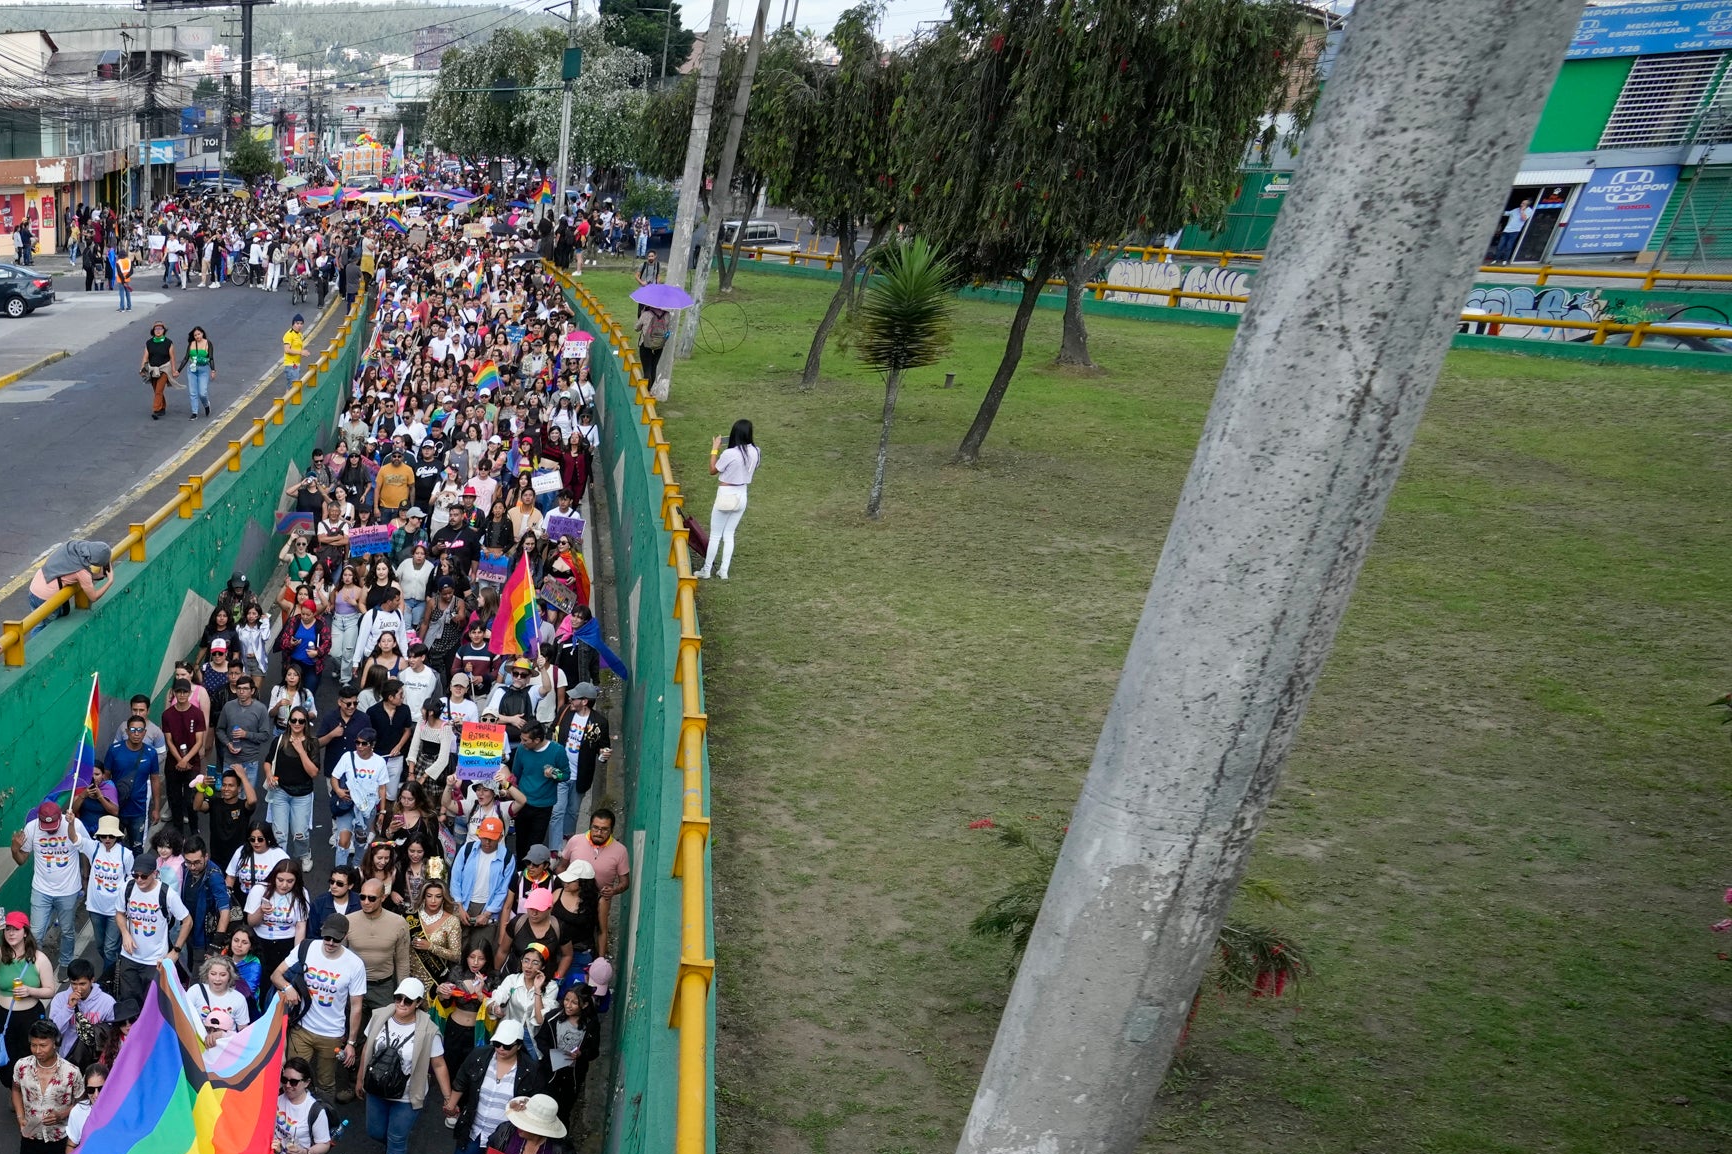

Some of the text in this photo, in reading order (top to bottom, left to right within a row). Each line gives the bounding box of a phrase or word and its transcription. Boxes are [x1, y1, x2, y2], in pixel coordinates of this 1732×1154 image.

[1581, 4, 1676, 17] MPORTADORES
[1608, 26, 1690, 38] ESPECIALIZADA
[1624, 21, 1679, 30] MECÁNICA
[1680, 41, 1703, 49] 244
[1588, 183, 1669, 193] AUTO JAPON
[39, 836, 67, 847] SOY
[40, 846, 69, 855] COMO
[43, 855, 69, 868] TU
[94, 859, 119, 873] SOY
[94, 876, 118, 893] TU
[129, 900, 158, 914] SOY
[126, 913, 157, 923] COMO
[132, 920, 156, 937] TU
[306, 966, 340, 985] SOY
[306, 980, 337, 994] COMO
[277, 1111, 297, 1132] OY
